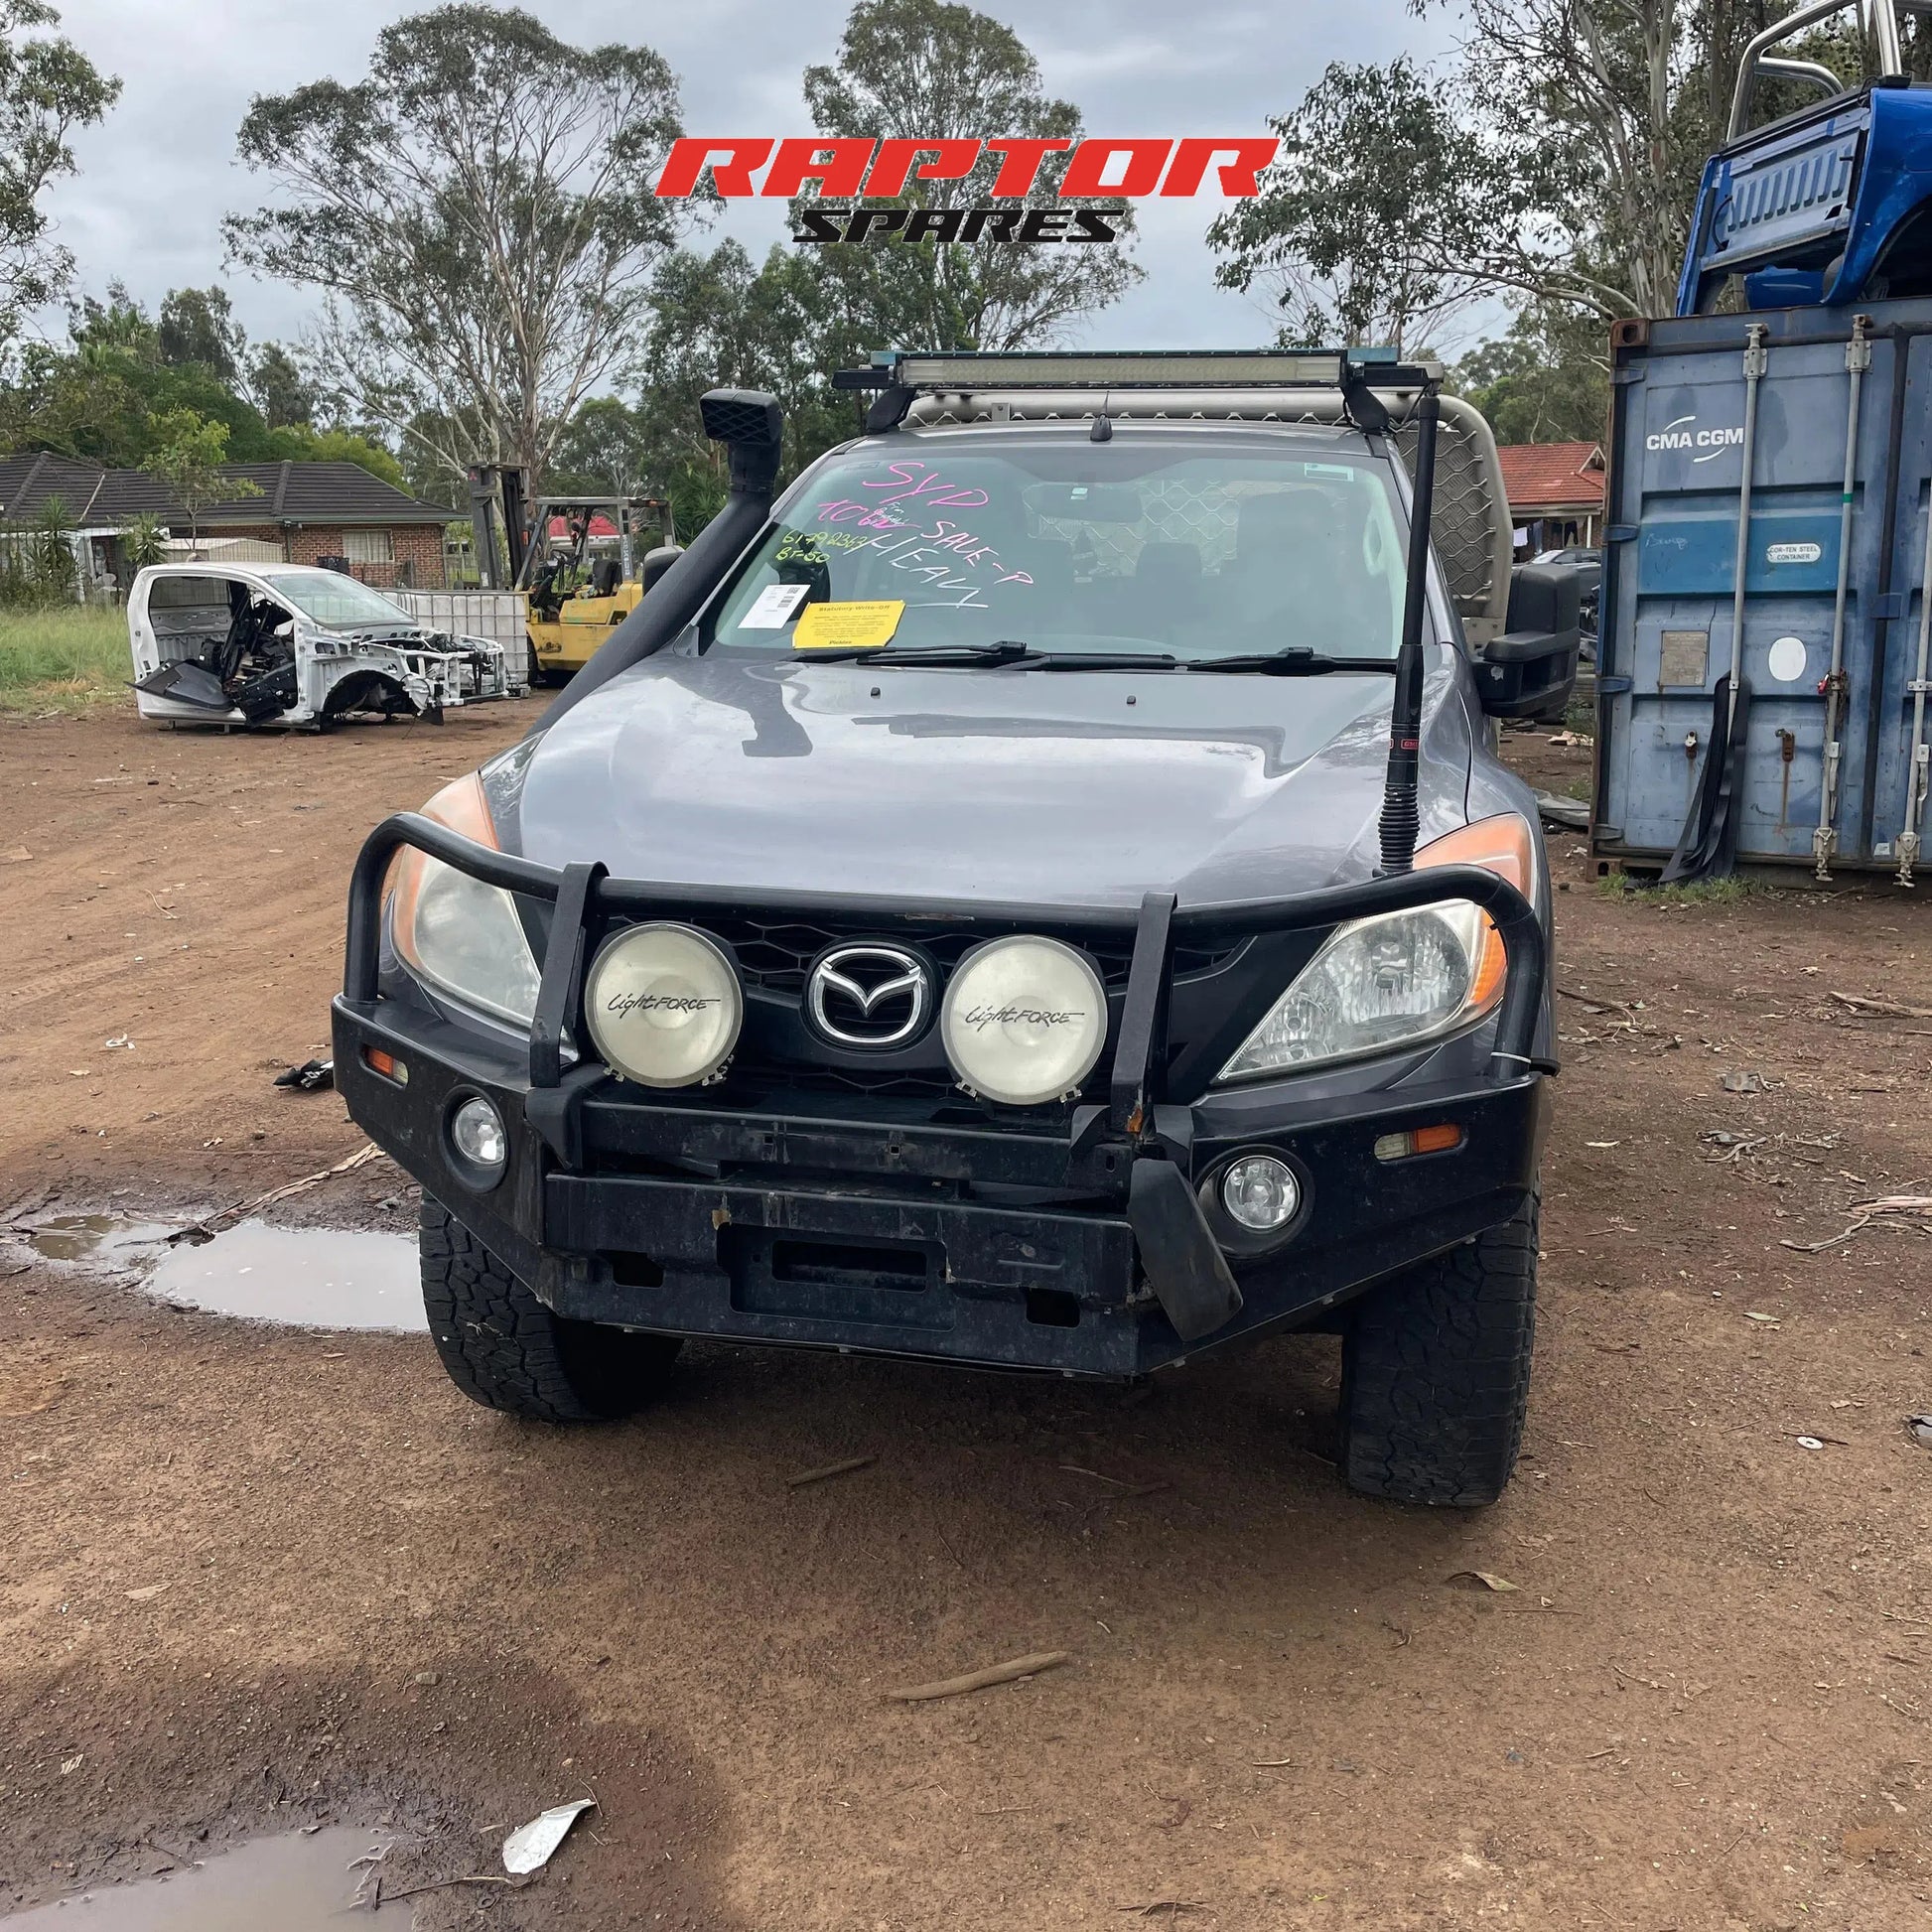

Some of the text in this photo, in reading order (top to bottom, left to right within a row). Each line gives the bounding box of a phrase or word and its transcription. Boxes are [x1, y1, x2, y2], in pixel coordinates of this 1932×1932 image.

[1647, 428, 1744, 450] CMA CGM
[862, 462, 989, 506] SYD
[775, 546, 831, 563] BT-50
